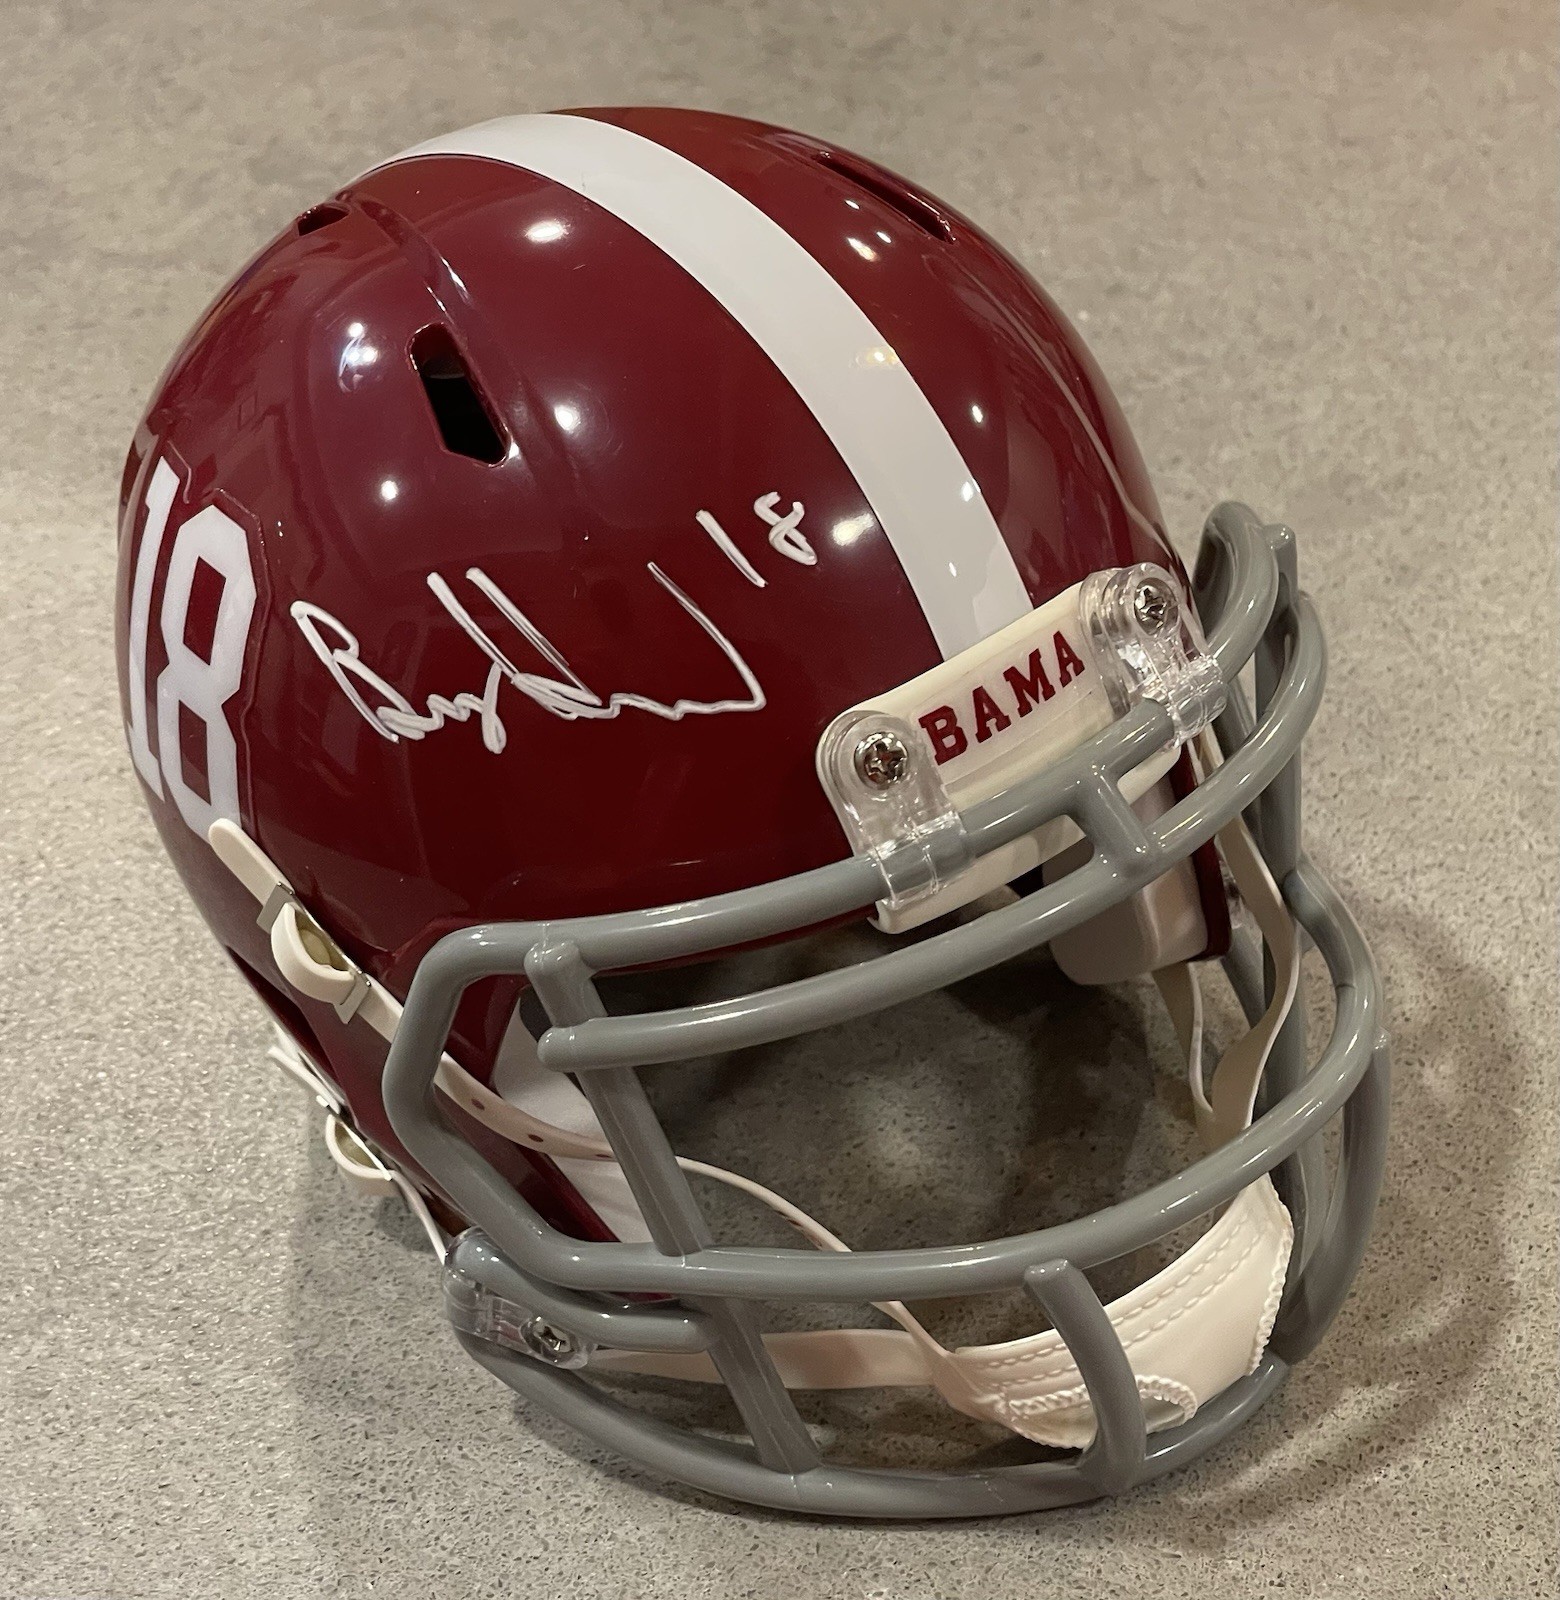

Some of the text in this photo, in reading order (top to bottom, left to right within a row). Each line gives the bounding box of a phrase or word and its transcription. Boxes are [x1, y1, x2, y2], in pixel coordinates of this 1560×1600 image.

[696, 491, 818, 587] 18
[129, 456, 257, 845] 18
[918, 630, 1085, 766] BAMA
